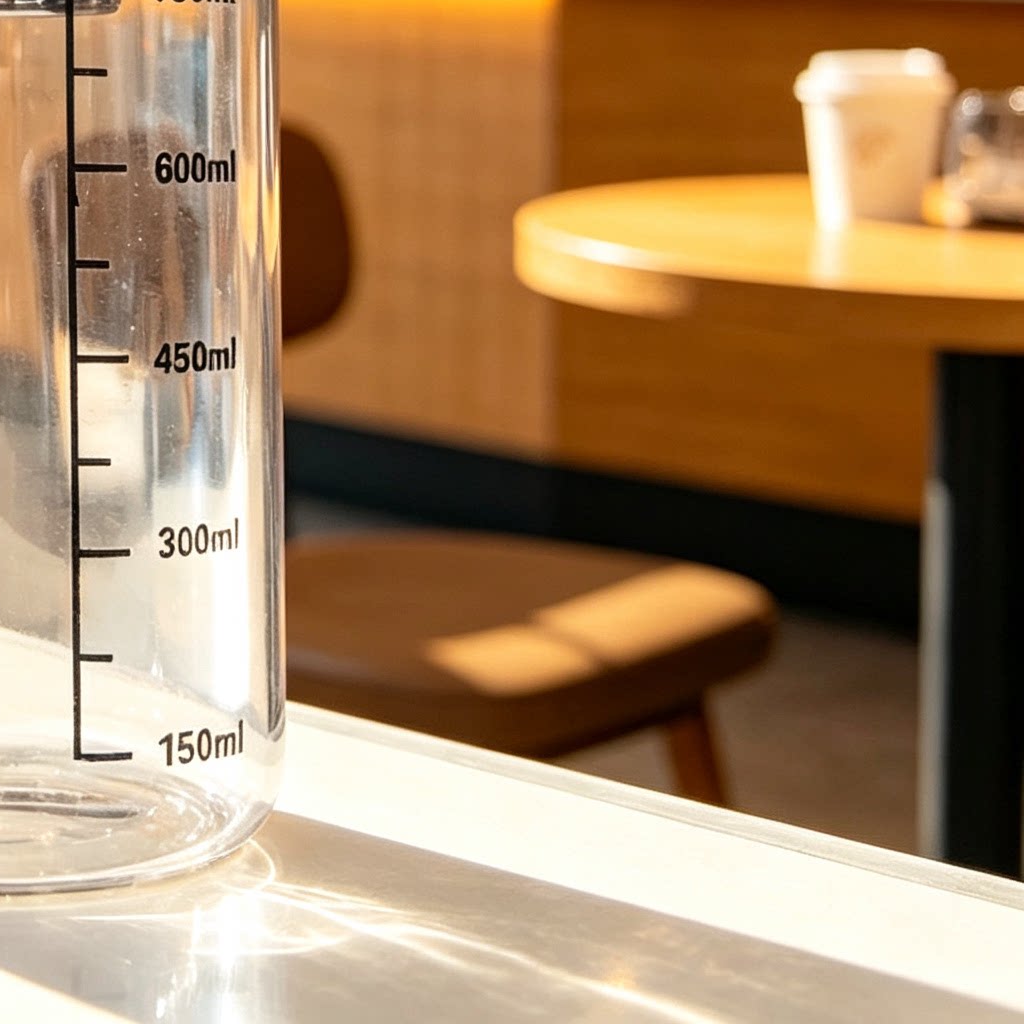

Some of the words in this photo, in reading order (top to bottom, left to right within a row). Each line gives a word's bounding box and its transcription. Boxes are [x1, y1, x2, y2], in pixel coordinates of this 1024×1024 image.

[154, 150, 237, 184] 600ml
[153, 336, 237, 374] 450ml
[158, 518, 240, 559] 300ml
[158, 719, 245, 767] 150ml
